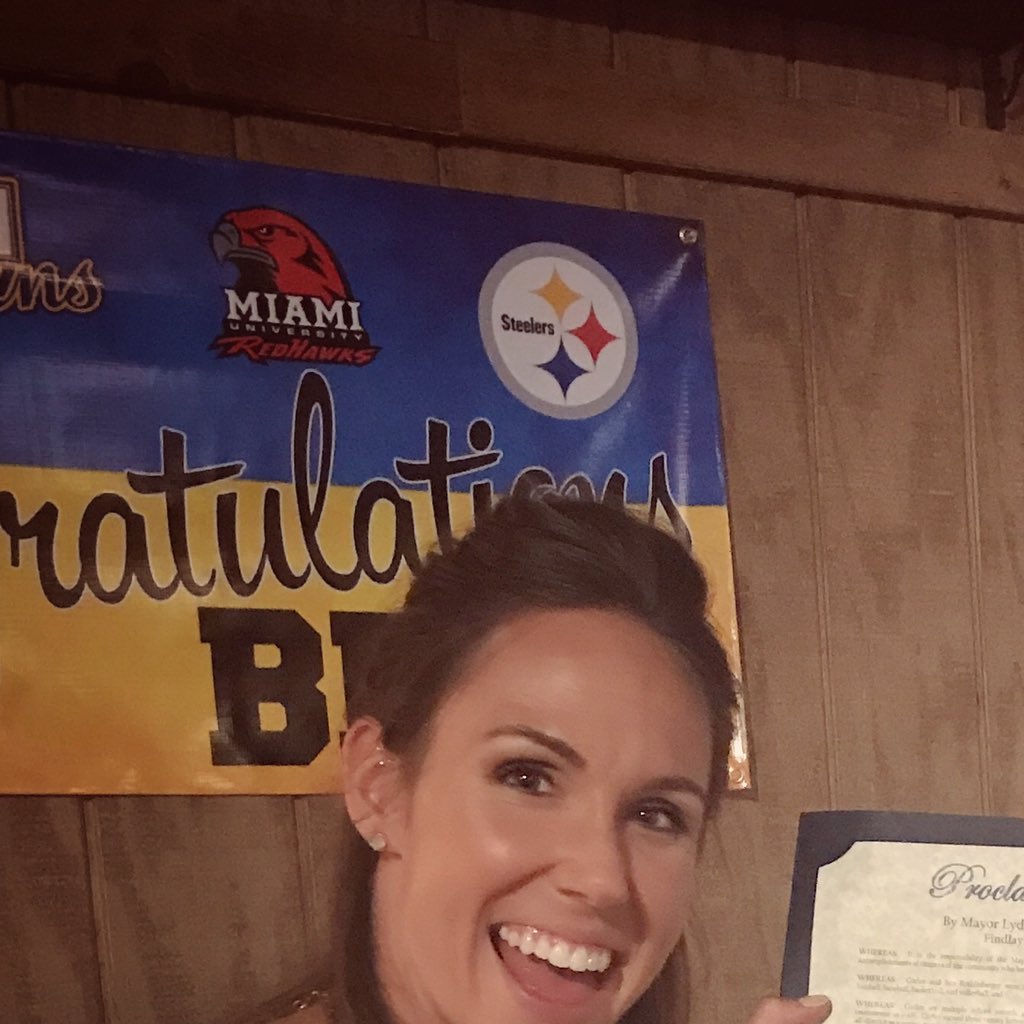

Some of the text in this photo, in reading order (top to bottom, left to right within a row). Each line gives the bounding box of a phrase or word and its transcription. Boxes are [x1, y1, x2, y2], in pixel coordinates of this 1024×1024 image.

[224, 288, 365, 332] MIAMI
[229, 322, 364, 342] UNIVERSITY
[501, 313, 555, 336] Steelers
[942, 915, 957, 930] By
[960, 916, 998, 932] Mayor
